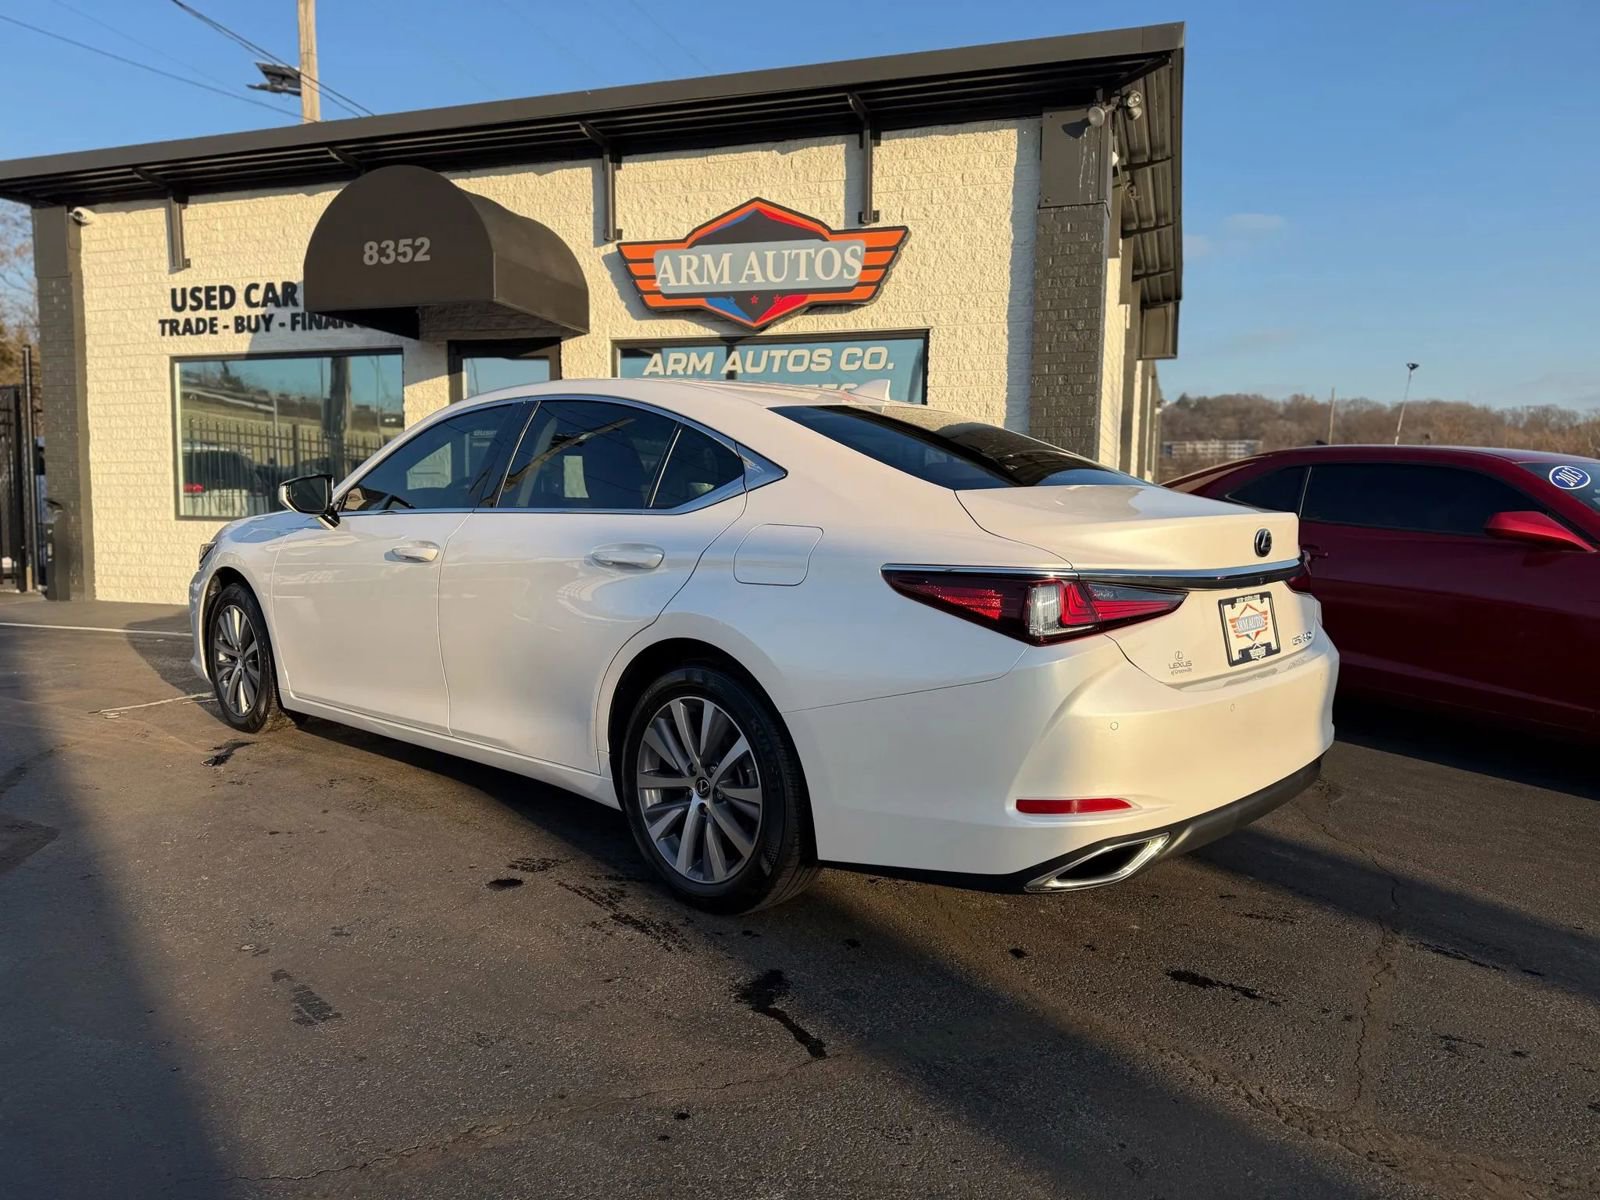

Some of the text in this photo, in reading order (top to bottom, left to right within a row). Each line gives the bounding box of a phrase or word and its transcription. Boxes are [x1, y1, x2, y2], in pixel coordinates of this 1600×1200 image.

[363, 237, 431, 266] 8352
[654, 245, 863, 287] ARM AUTOS
[170, 281, 299, 312] USED CAR
[159, 317, 219, 336] TRADE
[234, 313, 275, 334] BUY
[643, 346, 895, 376] ARM AUTOS CO.
[1555, 466, 1583, 488] 2013
[1168, 660, 1193, 670] LEXUS
